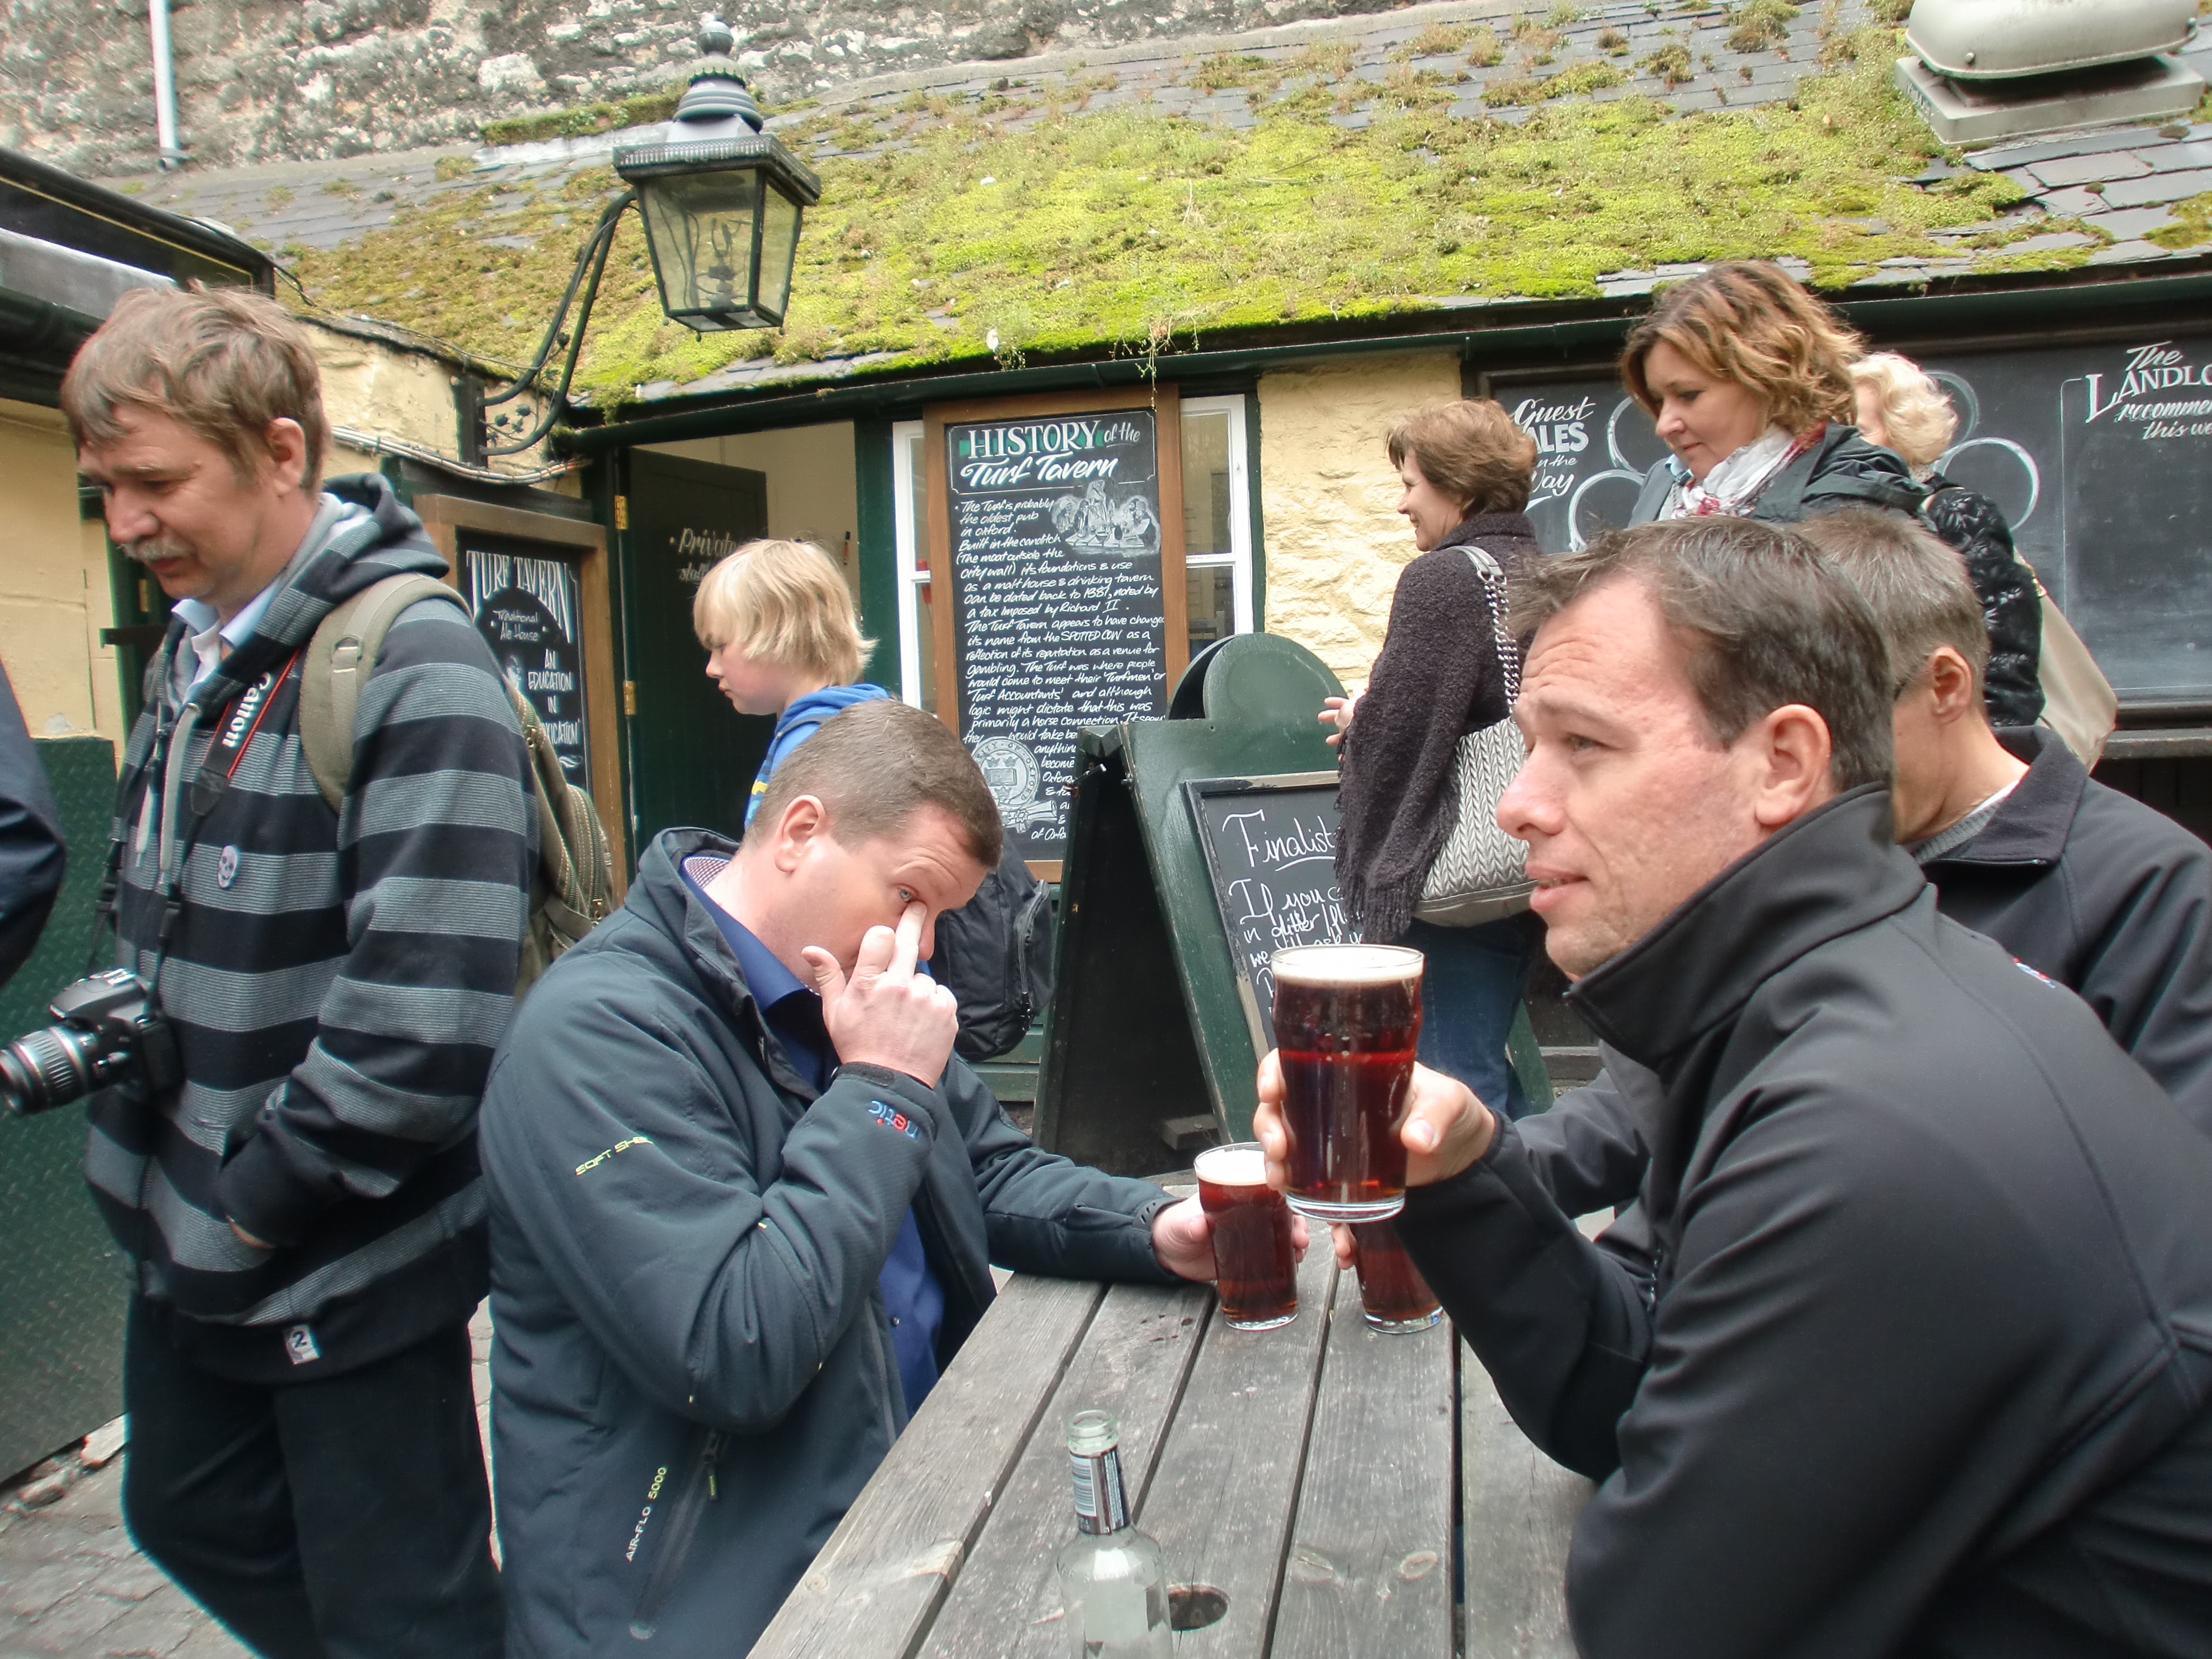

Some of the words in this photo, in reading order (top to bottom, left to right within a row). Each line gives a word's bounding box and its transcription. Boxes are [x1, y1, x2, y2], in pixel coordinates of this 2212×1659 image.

[2126, 341, 2183, 371] The
[1509, 397, 1596, 433] Guest
[968, 420, 1100, 458] HISTORY
[1104, 423, 1117, 442] of
[1119, 422, 1140, 442] the
[2142, 421, 2189, 440] this
[961, 456, 1031, 487] Turf
[1036, 451, 1118, 481] Tavern
[1537, 458, 1548, 467] n
[1549, 454, 1578, 467] the
[961, 500, 980, 512] The
[982, 499, 1006, 512] Turf
[1005, 502, 1013, 510] is
[1014, 498, 1055, 512] probably
[959, 513, 978, 524] the
[980, 512, 1014, 524] oldest
[1016, 511, 1039, 524] pub
[961, 527, 972, 536] in
[959, 536, 989, 551] Built
[989, 539, 1000, 549] in
[999, 536, 1018, 548] the
[957, 551, 978, 565] (The
[980, 551, 1007, 562] moat
[1007, 550, 1040, 561] outside
[1043, 547, 1065, 557] the
[961, 565, 988, 581] city
[987, 561, 1016, 576] wall)
[1021, 562, 1036, 575] its
[1039, 560, 1097, 574] foundations
[964, 583, 978, 592] as
[994, 578, 1023, 589] malt
[1022, 577, 1057, 588] house
[1068, 575, 1112, 587] drinking
[1114, 573, 1154, 583] tavern
[466, 550, 509, 622] TURF
[514, 556, 571, 643] TAVERN
[964, 594, 987, 604] can
[989, 592, 1001, 603] be
[1003, 590, 1038, 603] dated
[1039, 590, 1067, 601] back
[1070, 589, 1081, 599] to
[1114, 585, 1144, 597] noted
[1144, 584, 1159, 597] by
[967, 608, 975, 619] a
[979, 606, 999, 617] tax
[1045, 604, 1059, 618] by
[1060, 602, 1100, 612] Richard
[500, 622, 512, 640] Ale
[514, 624, 538, 641] House
[965, 620, 987, 633] The
[988, 619, 1014, 632] Turf
[1014, 619, 1047, 630] Tavern
[1051, 619, 1090, 630] appears
[1092, 615, 1103, 627] to
[1105, 615, 1126, 625] have
[968, 635, 982, 646] its
[985, 637, 1015, 646] name
[1018, 631, 1041, 644] from
[1043, 631, 1060, 642] the
[1061, 630, 1100, 641] SPOTTED
[1102, 629, 1123, 640] COW
[1142, 630, 1151, 639] a
[544, 648, 556, 669] AN
[966, 648, 1008, 661] reflection
[1011, 646, 1021, 658] of
[1022, 647, 1033, 658] its
[1036, 646, 1087, 660] reputation
[1102, 648, 1110, 656] a
[1142, 641, 1160, 654] for
[966, 662, 1019, 679] gambling.
[1021, 661, 1043, 673] The
[1044, 661, 1067, 671] Turf
[1093, 661, 1123, 670] where
[1126, 659, 1156, 670] people
[528, 671, 572, 691] EDUCATION
[968, 675, 1001, 687] would
[1001, 677, 1029, 686] come
[1032, 675, 1043, 685] to
[1045, 674, 1073, 685] meet
[1074, 672, 1101, 684] their
[1072, 686, 1097, 698] and
[1099, 686, 1152, 698] although
[222, 671, 272, 748] Canon
[547, 695, 557, 714] IN
[969, 703, 992, 719] logic
[997, 703, 1034, 718] might
[1036, 702, 1073, 714] dictate
[1078, 700, 1103, 712] that
[1103, 698, 1124, 711] this
[1130, 702, 1153, 711] was
[971, 717, 1019, 732] primarily
[1021, 718, 1029, 727] a
[1032, 716, 1058, 726] horse
[963, 731, 984, 744] they
[1008, 728, 1038, 740] would
[1039, 728, 1064, 740] take
[1065, 729, 1078, 739] be
[977, 742, 998, 760] SITY
[1034, 742, 1077, 757] anythin
[1031, 827, 1045, 839] of
[1222, 809, 1339, 867] Finalist
[1229, 878, 1276, 925] If
[1281, 888, 1326, 922] you
[1244, 927, 1261, 943] in
[1250, 951, 1271, 967] we
[575, 1149, 612, 1176] SOFT
[625, 1506, 652, 1563] AIR-FLO
[647, 1467, 667, 1500] 5000
